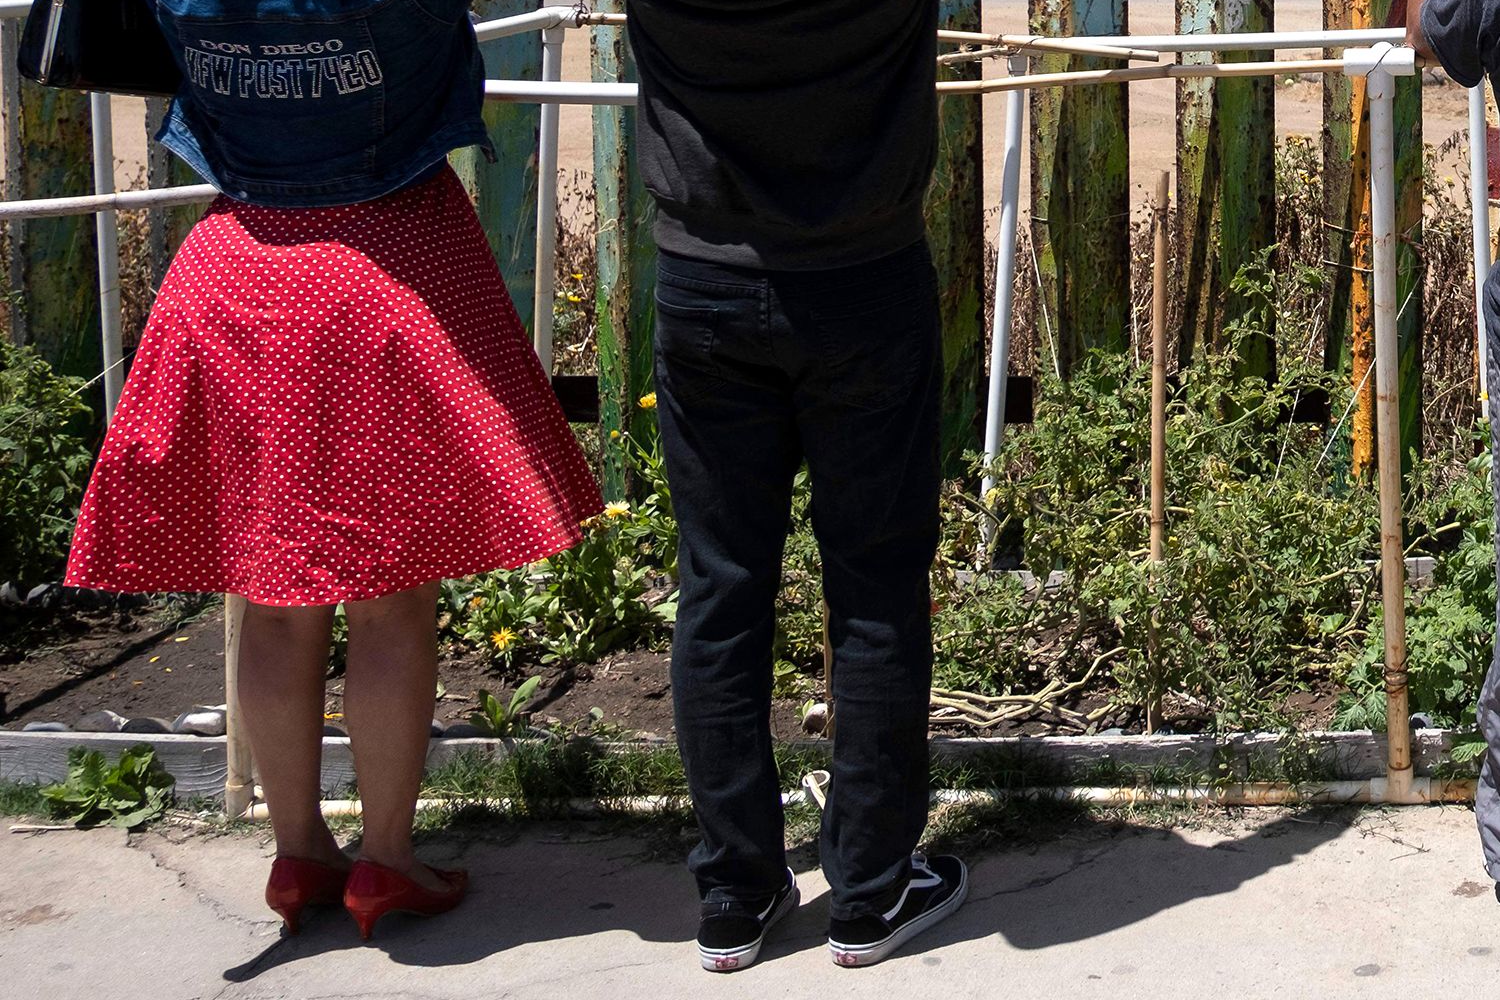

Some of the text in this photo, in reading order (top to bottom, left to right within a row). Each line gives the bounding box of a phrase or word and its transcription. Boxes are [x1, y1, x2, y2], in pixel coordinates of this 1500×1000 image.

[200, 39, 344, 56] DON DIEGO
[184, 46, 384, 99] VFW POST 7420
